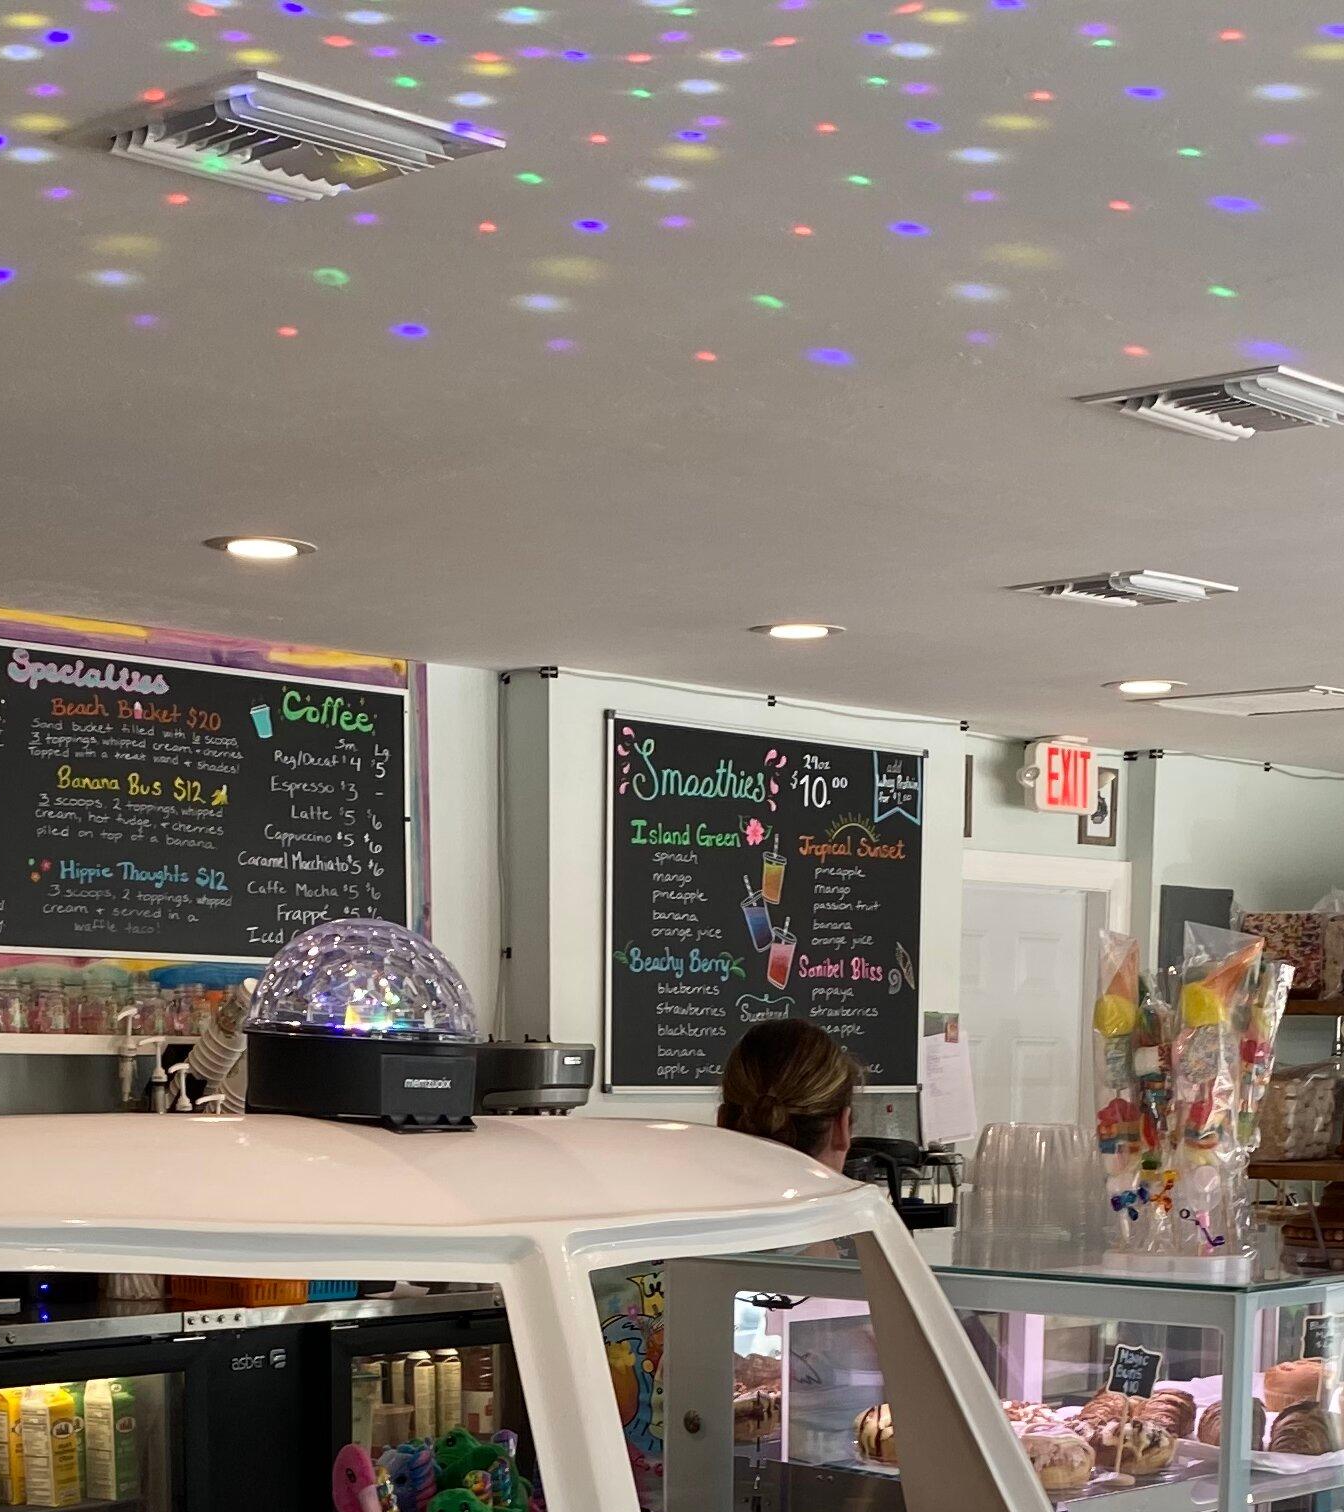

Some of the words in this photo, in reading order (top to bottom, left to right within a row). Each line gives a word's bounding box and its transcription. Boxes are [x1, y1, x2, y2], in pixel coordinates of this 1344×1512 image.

[7, 648, 170, 694] Specialties
[51, 695, 110, 716] Beach
[187, 706, 222, 731] $20
[282, 690, 375, 733] Coffee
[30, 718, 63, 730] Sand
[72, 721, 113, 733] bucket
[633, 738, 766, 801] Smoothies
[56, 765, 120, 790] Banana
[127, 772, 163, 796] Bus
[173, 776, 206, 804] $12
[1047, 747, 1091, 809] EXIT
[270, 774, 335, 799] Espresso
[291, 804, 333, 821] Latte
[99, 827, 123, 842] top
[264, 823, 333, 848] Cappuccino
[337, 831, 355, 847] $5
[631, 819, 690, 845] Island
[696, 824, 741, 847] Green
[798, 835, 851, 860] Tropical
[858, 839, 906, 858] Sunset
[237, 850, 288, 870] Caramel
[653, 851, 698, 864] spinach
[60, 859, 114, 884] Hippie
[116, 861, 190, 888] Thoughts
[195, 867, 229, 891] $12
[653, 871, 692, 887] mango
[815, 866, 866, 879] pineapple
[295, 883, 339, 898] Mocha
[343, 884, 360, 900] $5
[653, 890, 708, 903] pineapple
[814, 883, 851, 899] mango
[43, 903, 89, 914] cream
[112, 905, 163, 919] served
[653, 909, 698, 921] banana
[813, 902, 853, 913] passion
[856, 901, 880, 911] fruit
[813, 920, 853, 931] banana
[246, 927, 285, 943] Iced
[652, 929, 692, 941] orange
[696, 927, 723, 940] juice
[811, 935, 848, 949] orange
[630, 947, 684, 978] Beachy
[690, 948, 731, 981] Berry
[798, 955, 844, 979] Sanibel
[851, 957, 883, 980] Bliss
[657, 982, 720, 995] blueberries
[811, 986, 854, 1001] papaya
[810, 1005, 879, 1017] strawberries
[657, 1025, 726, 1037] blackberries
[657, 1045, 706, 1057] banana
[657, 1064, 689, 1078] apple
